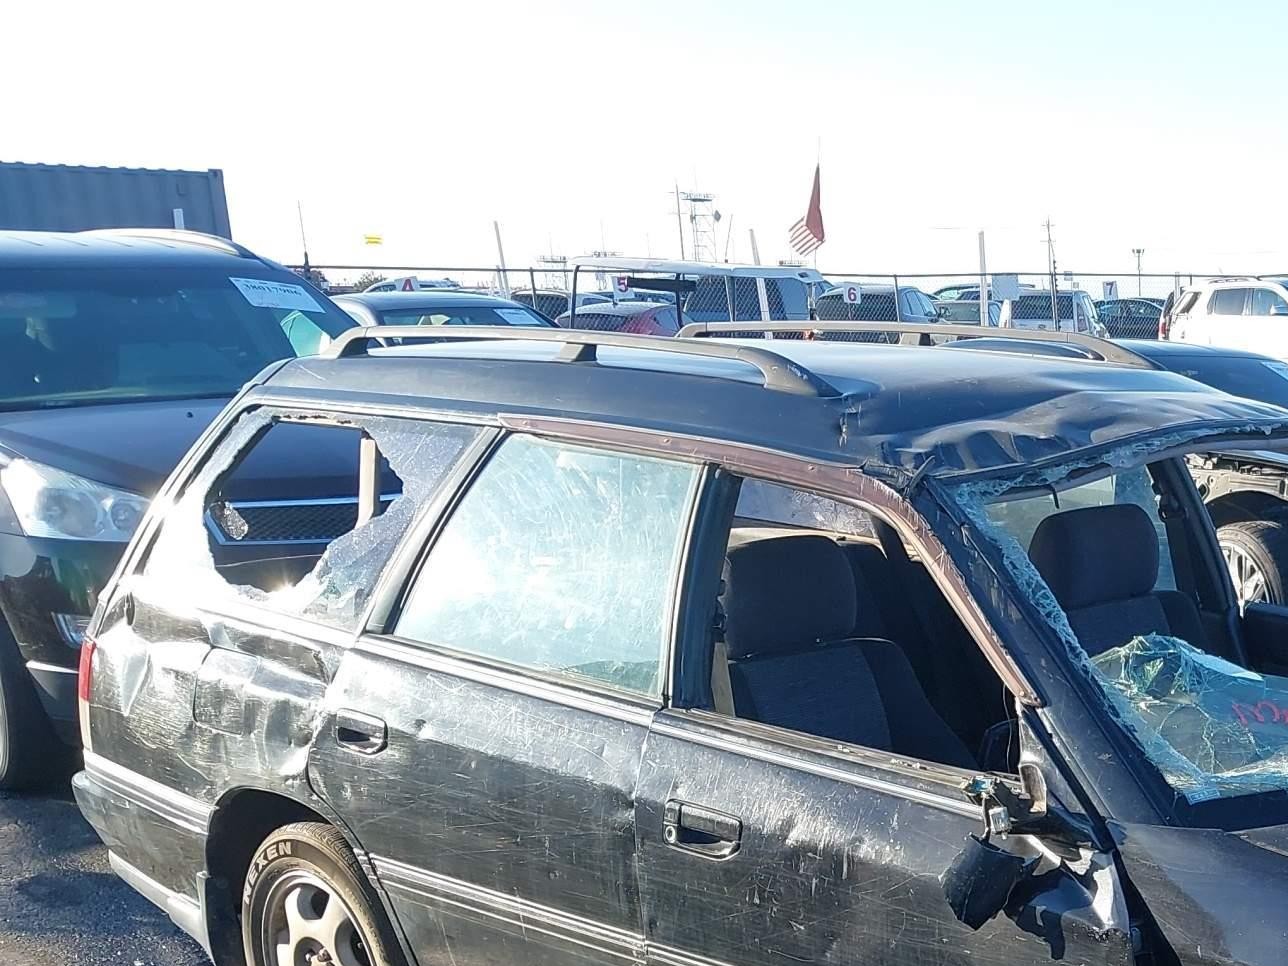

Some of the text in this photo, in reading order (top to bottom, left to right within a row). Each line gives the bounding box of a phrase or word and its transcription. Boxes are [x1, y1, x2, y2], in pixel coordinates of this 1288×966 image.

[617, 276, 628, 293] 5
[1105, 283, 1114, 296] 7
[847, 286, 858, 302] 6
[243, 841, 292, 905] NEXEN
